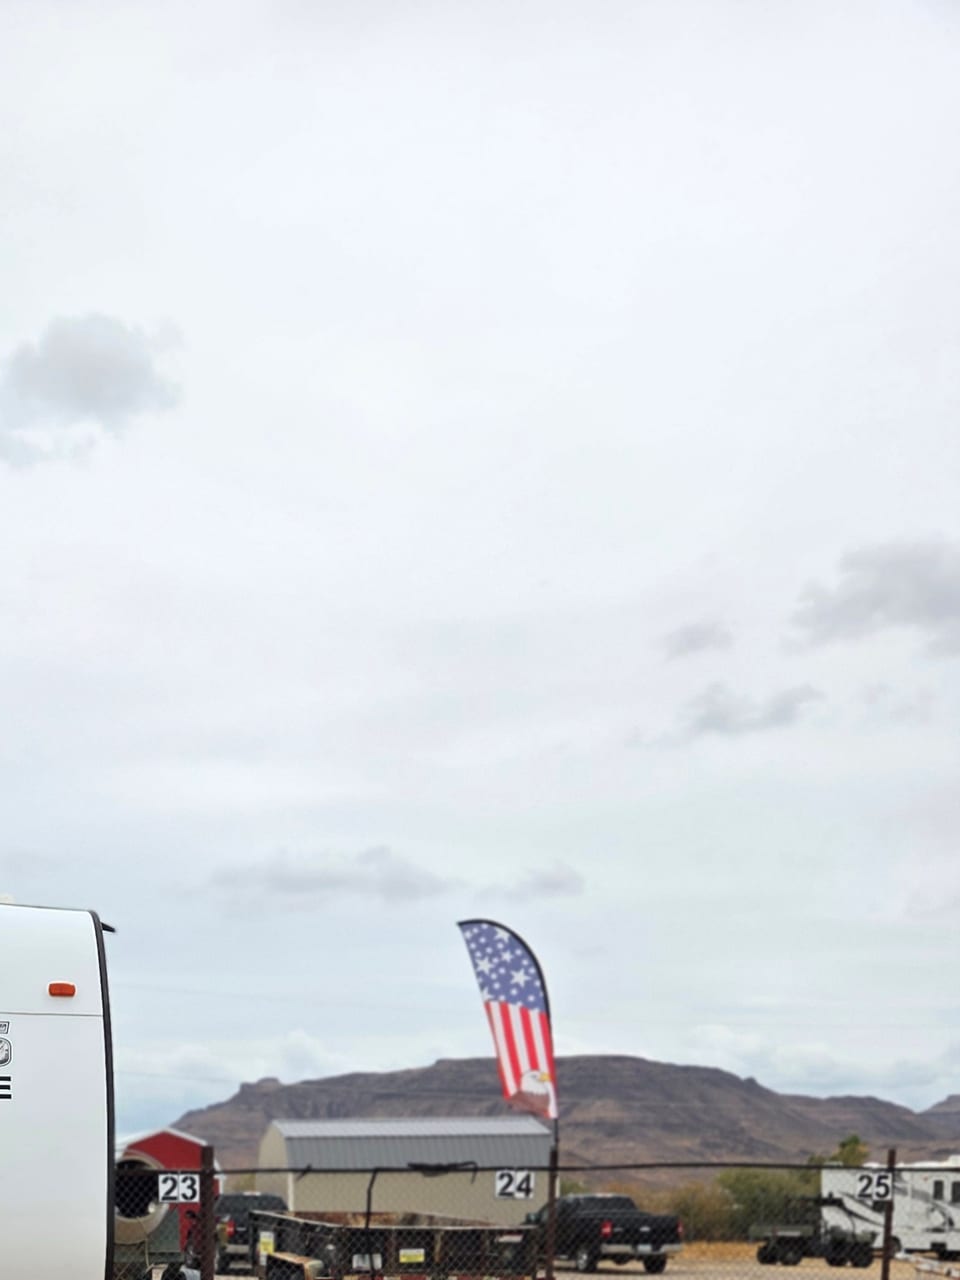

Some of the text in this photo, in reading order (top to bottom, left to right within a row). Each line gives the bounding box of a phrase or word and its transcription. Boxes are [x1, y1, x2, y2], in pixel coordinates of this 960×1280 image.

[161, 1175, 197, 1201] 23
[498, 1172, 532, 1197] 24
[858, 1174, 890, 1199] 25
